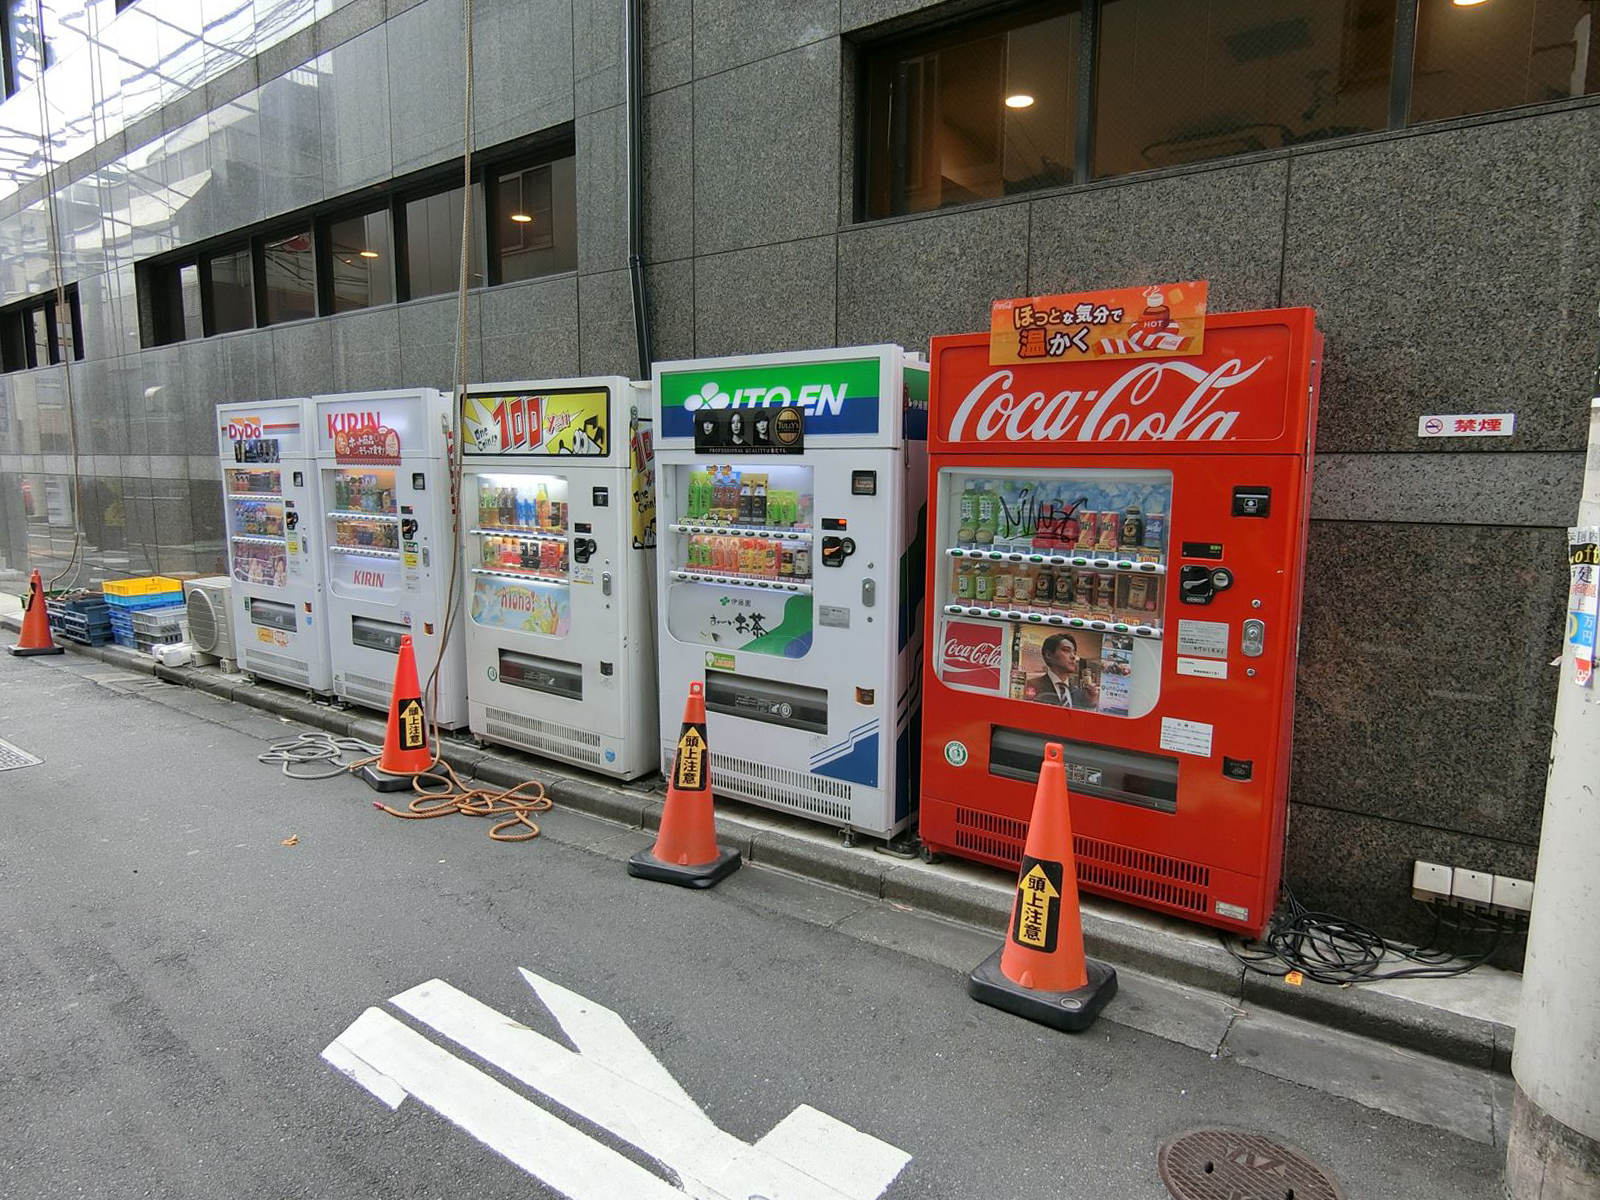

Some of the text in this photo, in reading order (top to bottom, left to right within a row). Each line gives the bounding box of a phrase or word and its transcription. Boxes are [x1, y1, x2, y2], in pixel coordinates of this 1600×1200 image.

[1014, 303, 1123, 329] ほっとな気分で
[1143, 320, 1164, 328] HOT
[1018, 327, 1090, 358] 温かく
[948, 358, 1269, 442] Coca-Cola
[228, 423, 261, 440] DyDo
[491, 396, 543, 452] 100
[1454, 419, 1502, 432] 禁煙
[353, 570, 385, 588] KIRIN
[731, 598, 751, 607] 伊藤園
[944, 638, 1002, 667] Coca-Cola
[682, 735, 699, 785] 頭上注意
[1022, 873, 1047, 942] 頭上注意
